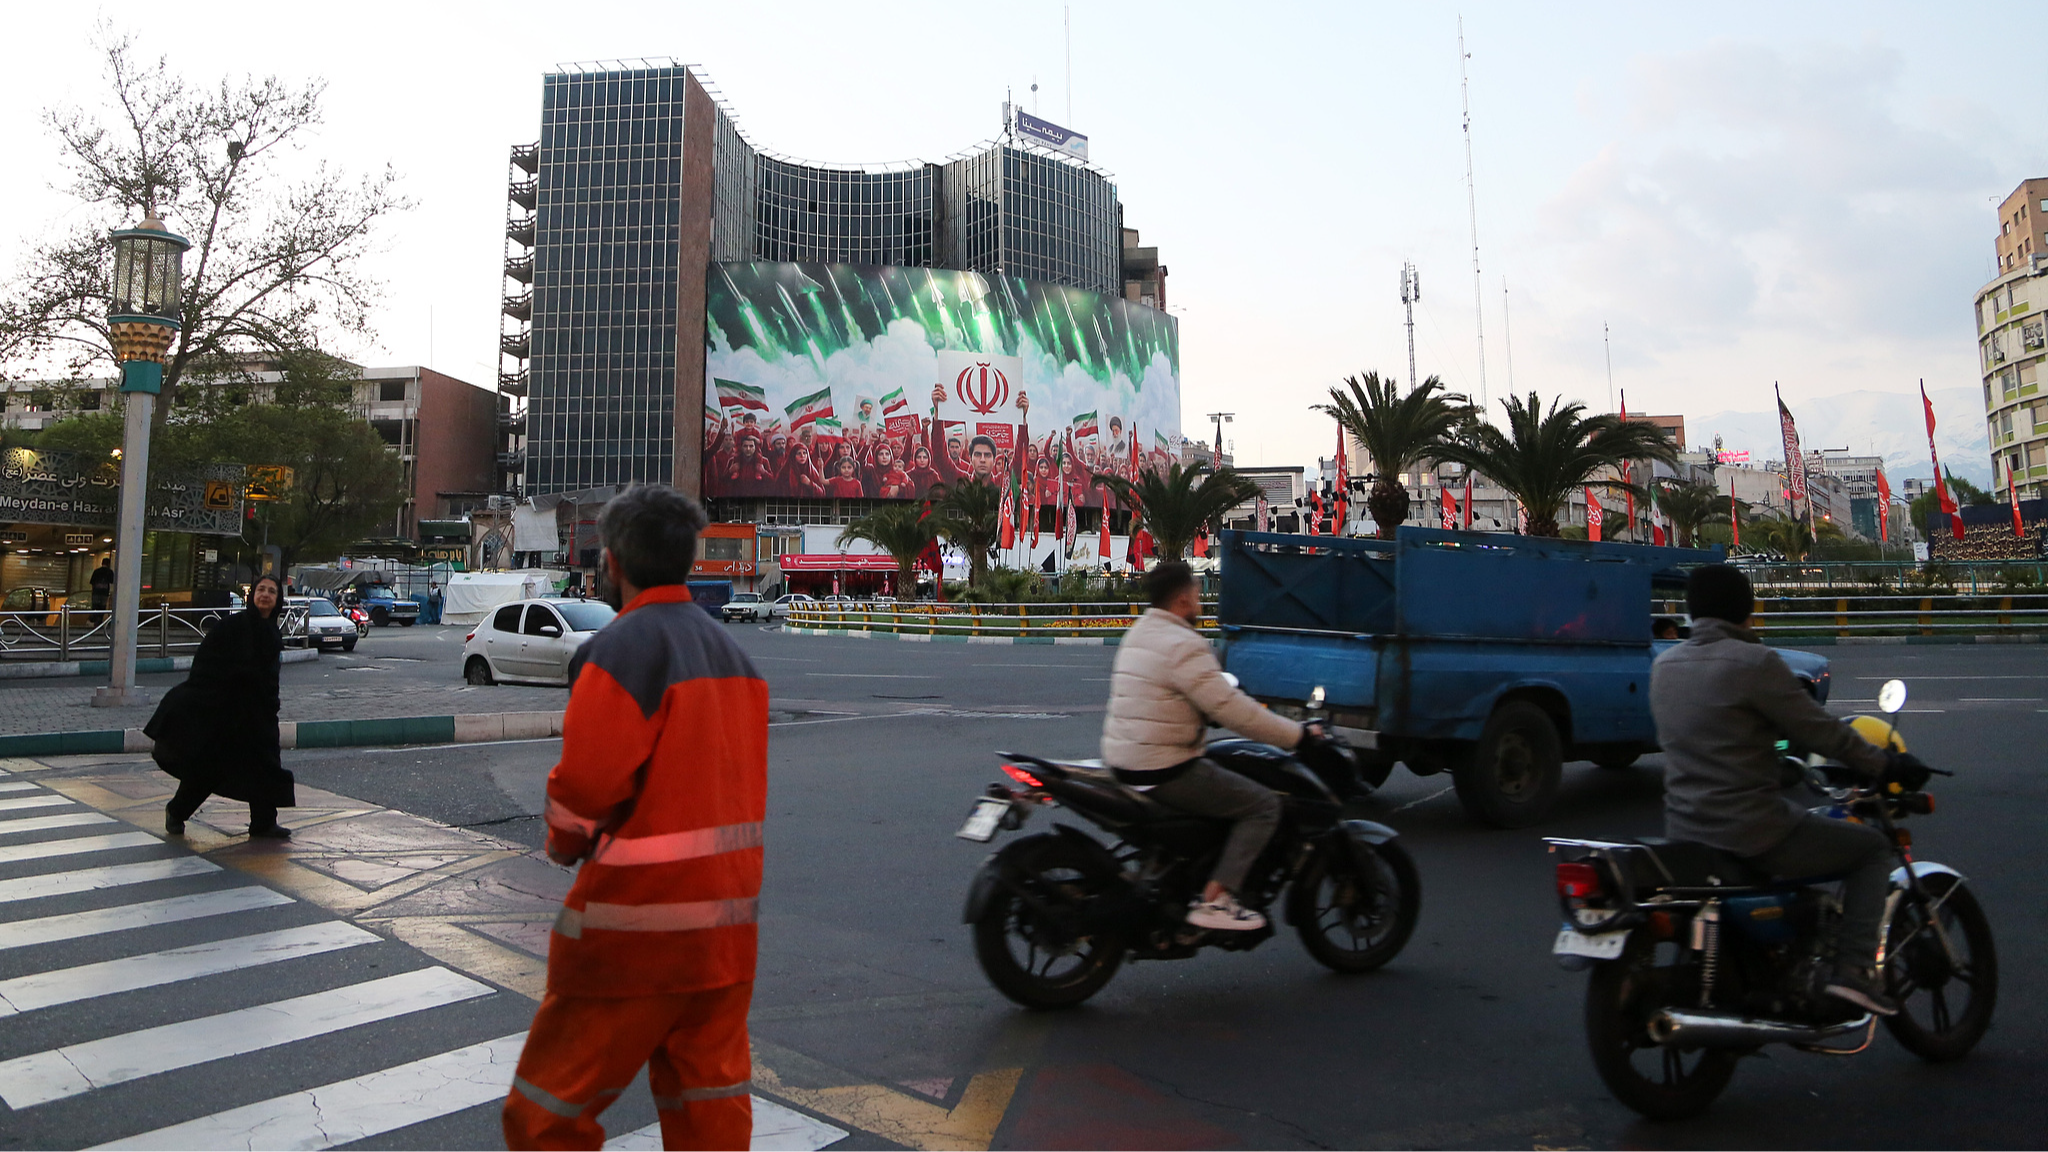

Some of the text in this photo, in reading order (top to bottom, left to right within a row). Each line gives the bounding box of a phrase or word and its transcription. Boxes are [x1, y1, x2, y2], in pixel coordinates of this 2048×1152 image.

[22, 471, 57, 483] عصر
[61, 472, 87, 488] ولی
[0, 495, 69, 511] Meydan-e
[161, 506, 185, 518] Asr
